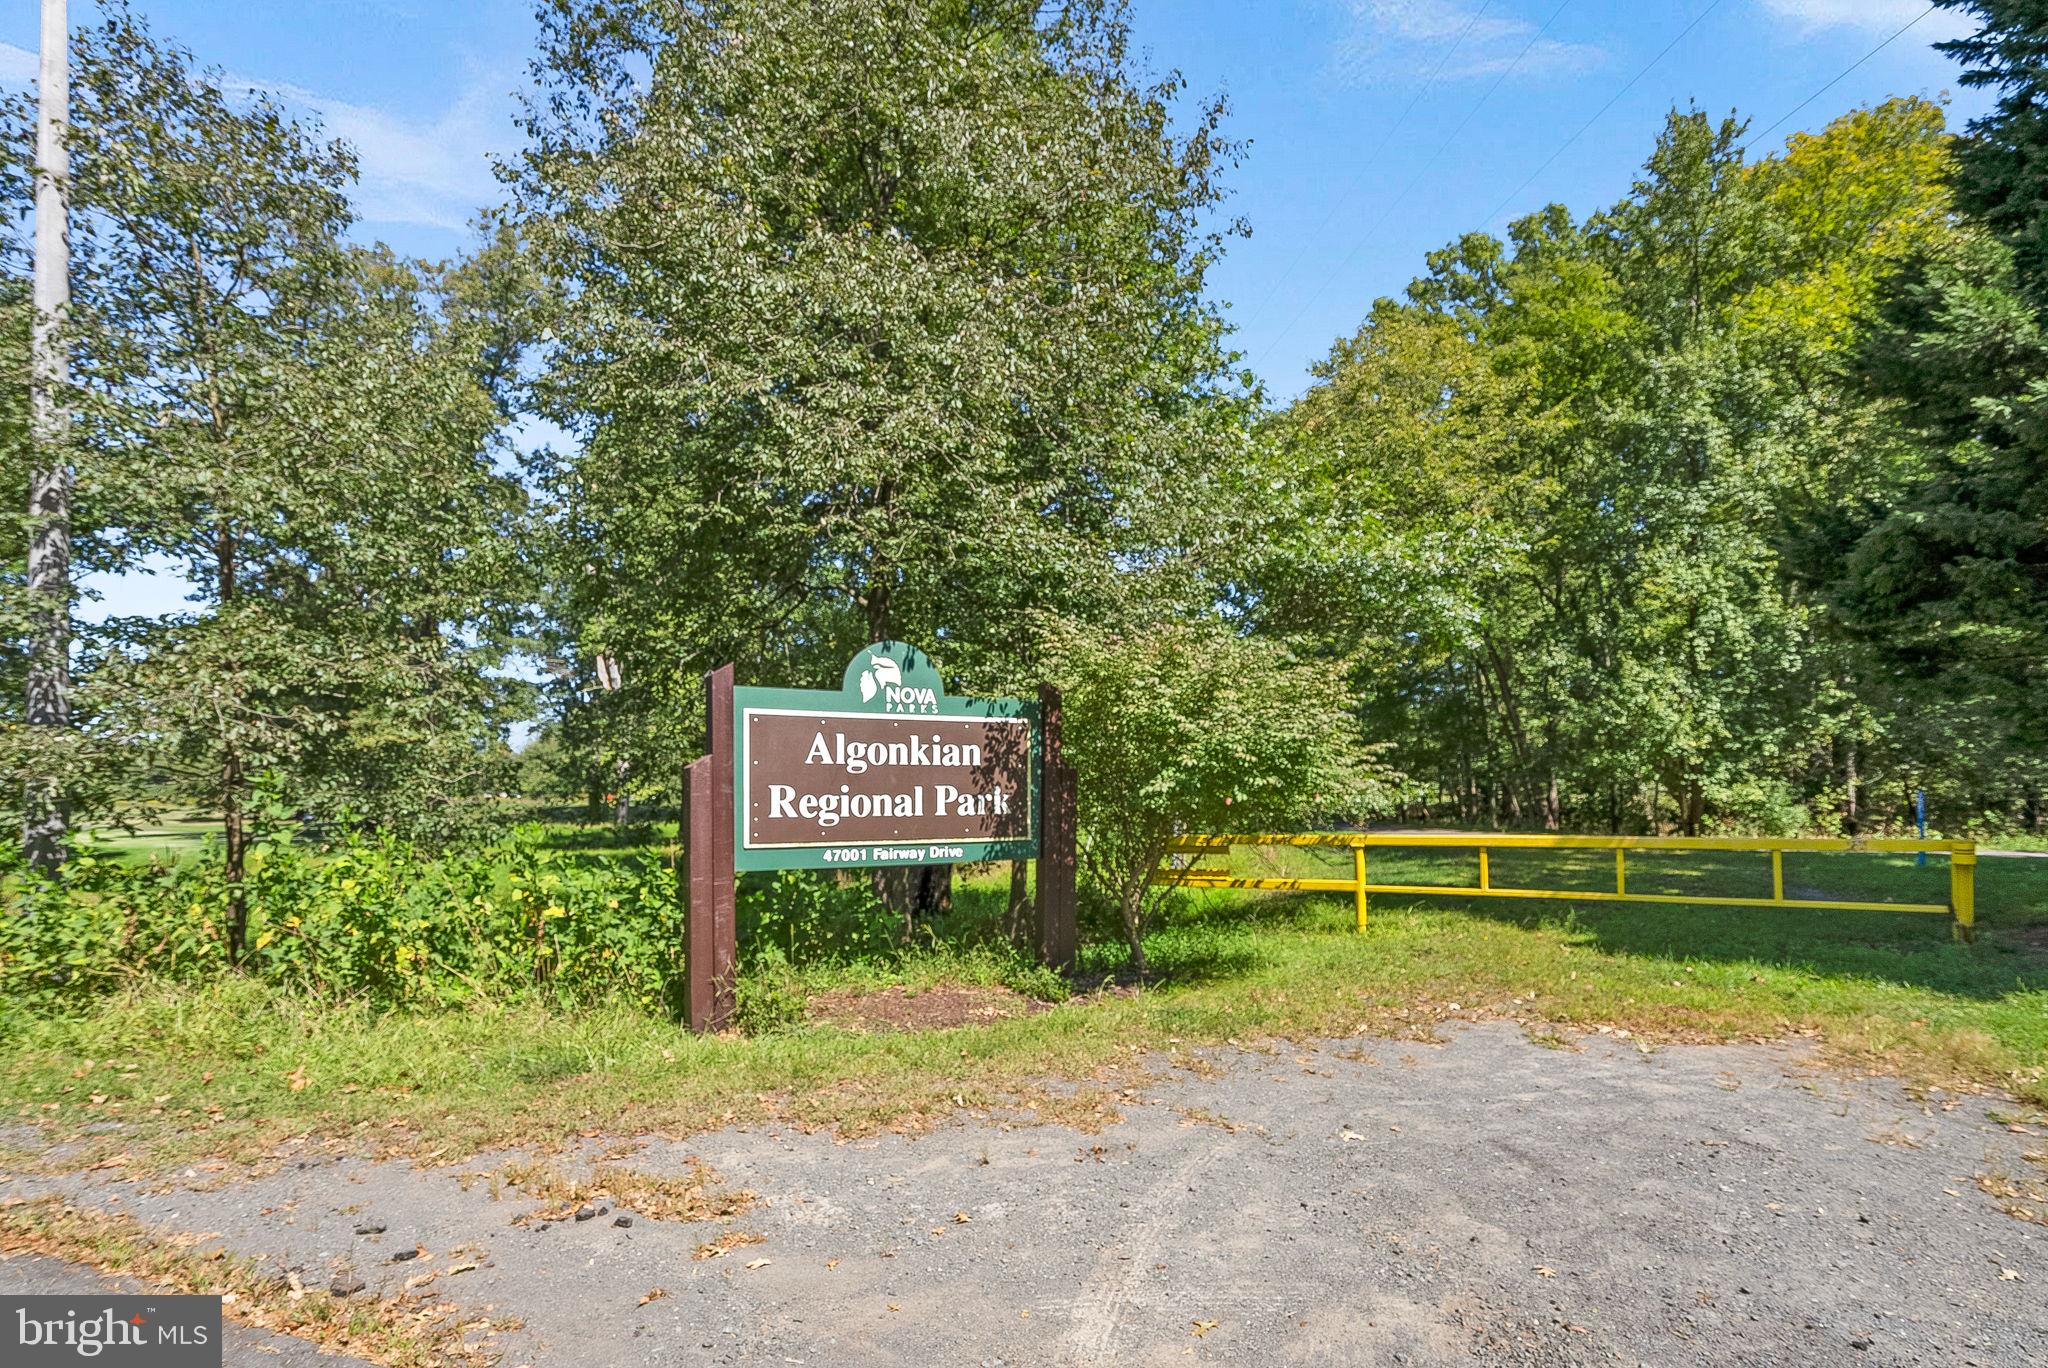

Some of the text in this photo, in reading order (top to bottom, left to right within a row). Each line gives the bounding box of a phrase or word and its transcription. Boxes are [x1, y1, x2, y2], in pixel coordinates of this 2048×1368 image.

[885, 685, 937, 705] NOVA
[885, 703, 939, 714] PARKS
[804, 731, 982, 775] Algonkian
[768, 784, 1010, 827] Regional Park
[823, 845, 964, 862] 47001 Fairway Drive
